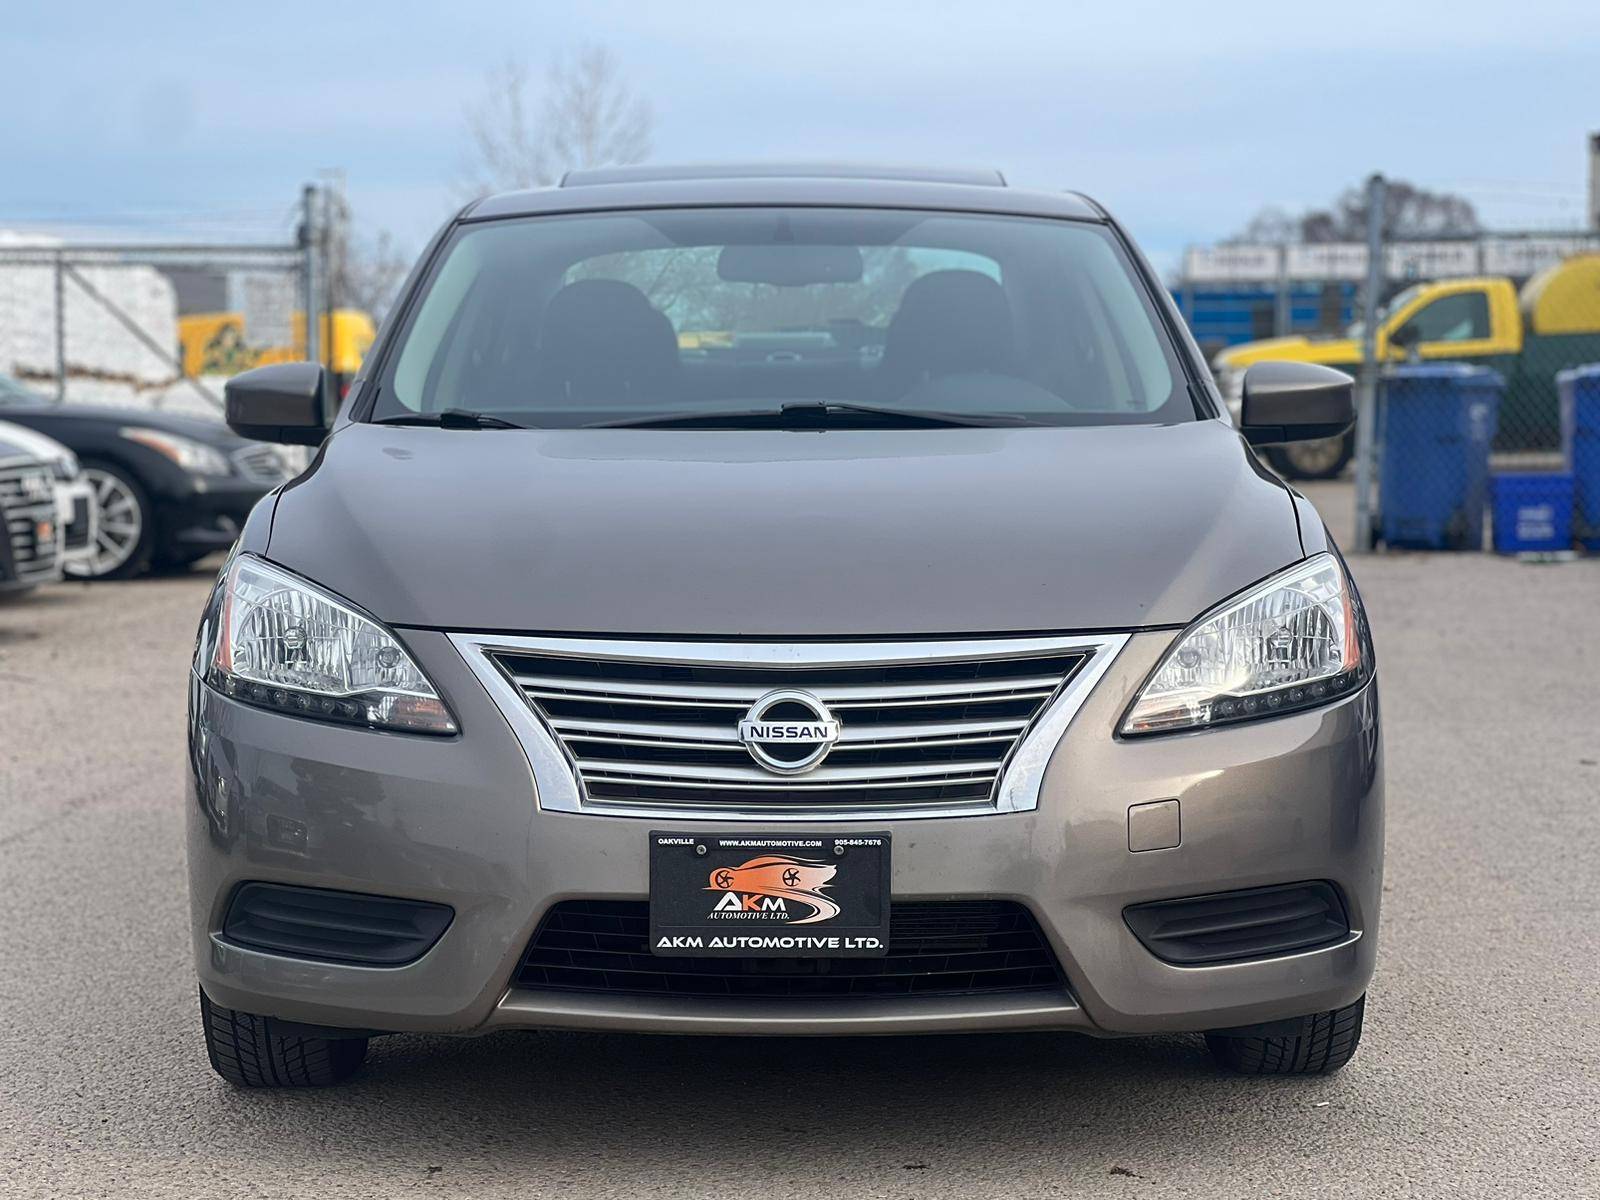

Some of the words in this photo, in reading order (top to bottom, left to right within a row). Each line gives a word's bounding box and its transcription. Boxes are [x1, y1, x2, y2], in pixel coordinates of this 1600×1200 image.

[750, 726, 828, 738] NISSAN
[713, 891, 787, 912] AKM
[707, 912, 768, 920] AUTOMOTIVE
[769, 912, 790, 920] LTD.
[656, 936, 703, 949] AKM
[708, 937, 840, 949] AUTOMOTIVE
[844, 938, 884, 949] LTD.
